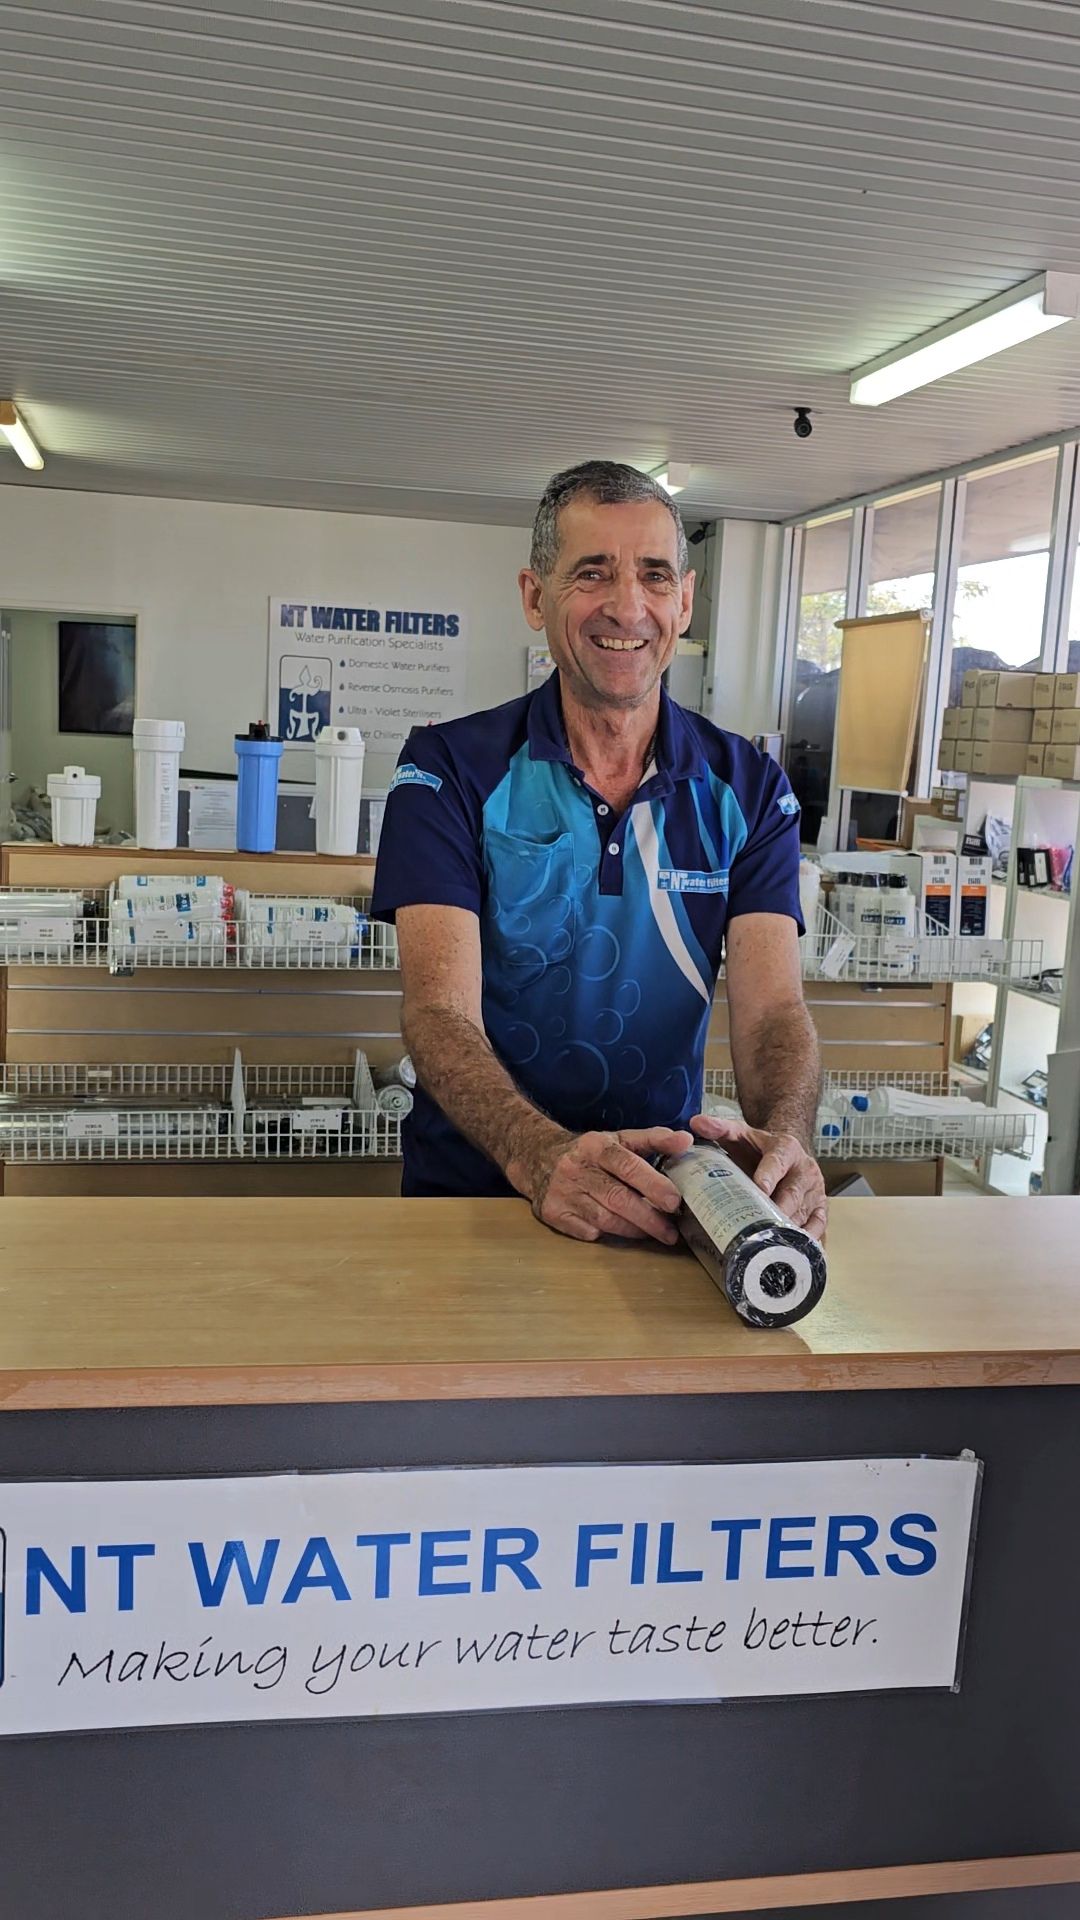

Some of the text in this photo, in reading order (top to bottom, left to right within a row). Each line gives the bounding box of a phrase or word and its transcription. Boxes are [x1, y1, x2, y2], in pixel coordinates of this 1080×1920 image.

[280, 604, 460, 637] NT WATER FILTERS
[295, 632, 444, 651] Water Purification Specialists
[349, 659, 450, 673] Domestic Water Purifiers
[348, 682, 454, 696] Reverse Osmosis Purifiers
[347, 705, 367, 715] Ultra
[375, 707, 400, 717] Violet
[373, 730, 404, 740] Chillers
[671, 872, 729, 889] NT wate filter
[25, 1514, 937, 1617] NT WATER FILTERS
[57, 1606, 878, 1695] Making your water taste better.
